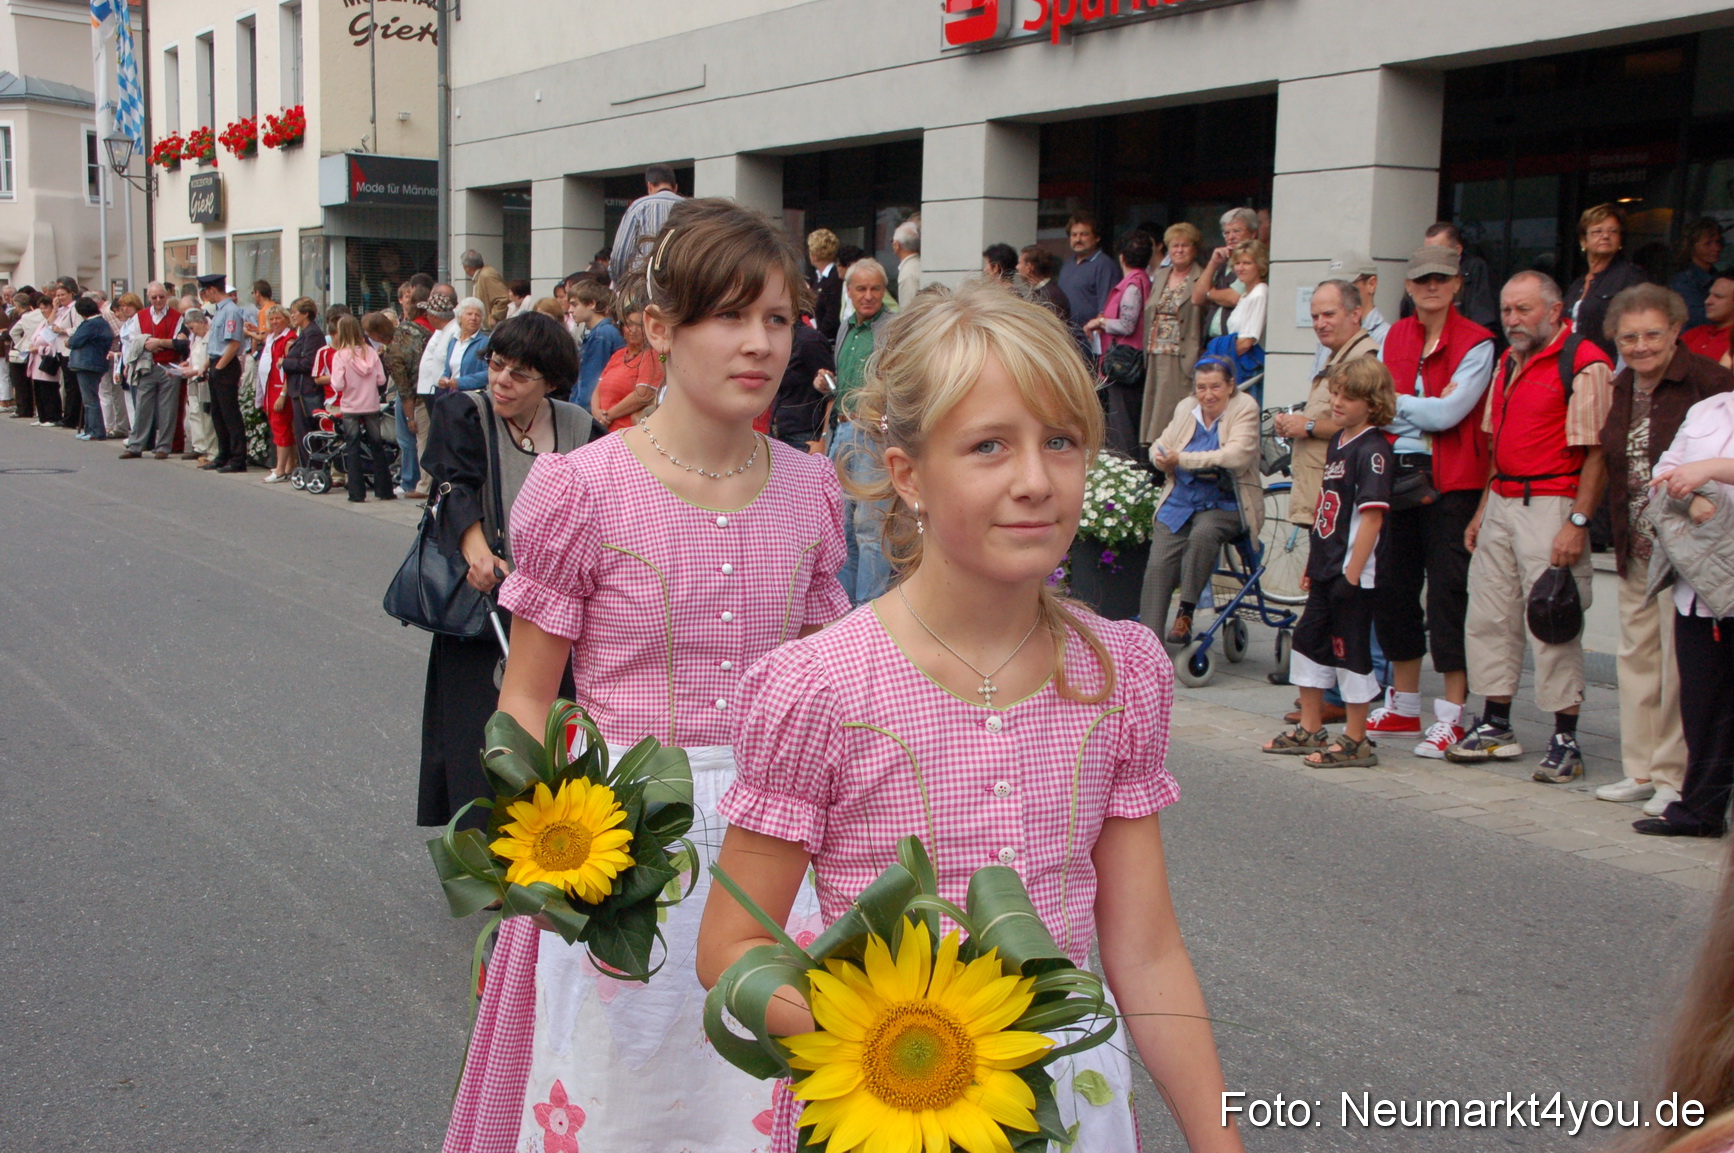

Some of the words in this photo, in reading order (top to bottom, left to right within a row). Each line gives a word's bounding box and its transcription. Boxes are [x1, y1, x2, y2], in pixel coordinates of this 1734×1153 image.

[356, 182, 385, 193] Mode
[387, 183, 400, 194] für
[1371, 453, 1385, 474] 9
